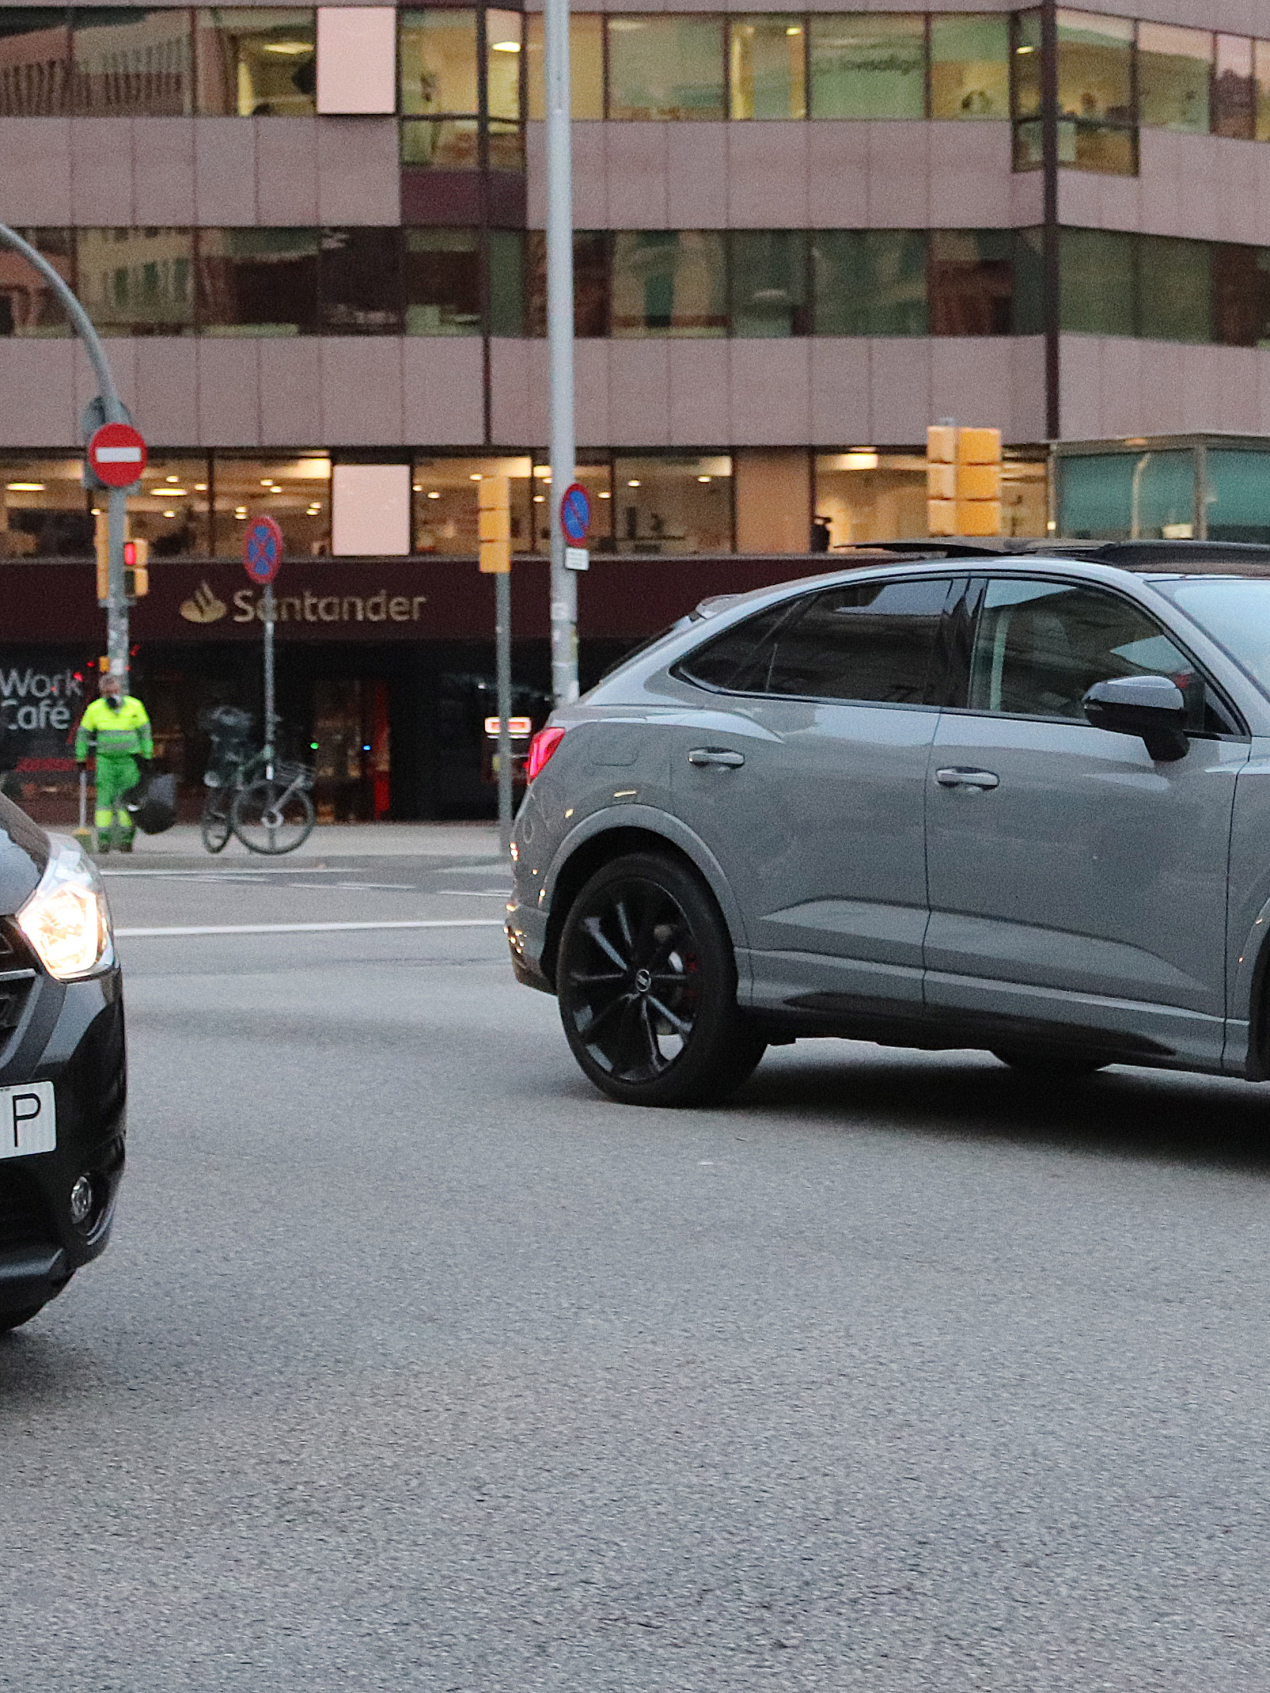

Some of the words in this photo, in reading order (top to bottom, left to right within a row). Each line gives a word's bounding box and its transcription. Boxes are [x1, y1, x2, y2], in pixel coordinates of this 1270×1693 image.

[232, 588, 427, 623] Santander
[0, 668, 83, 697] Work
[0, 698, 70, 730] Café
